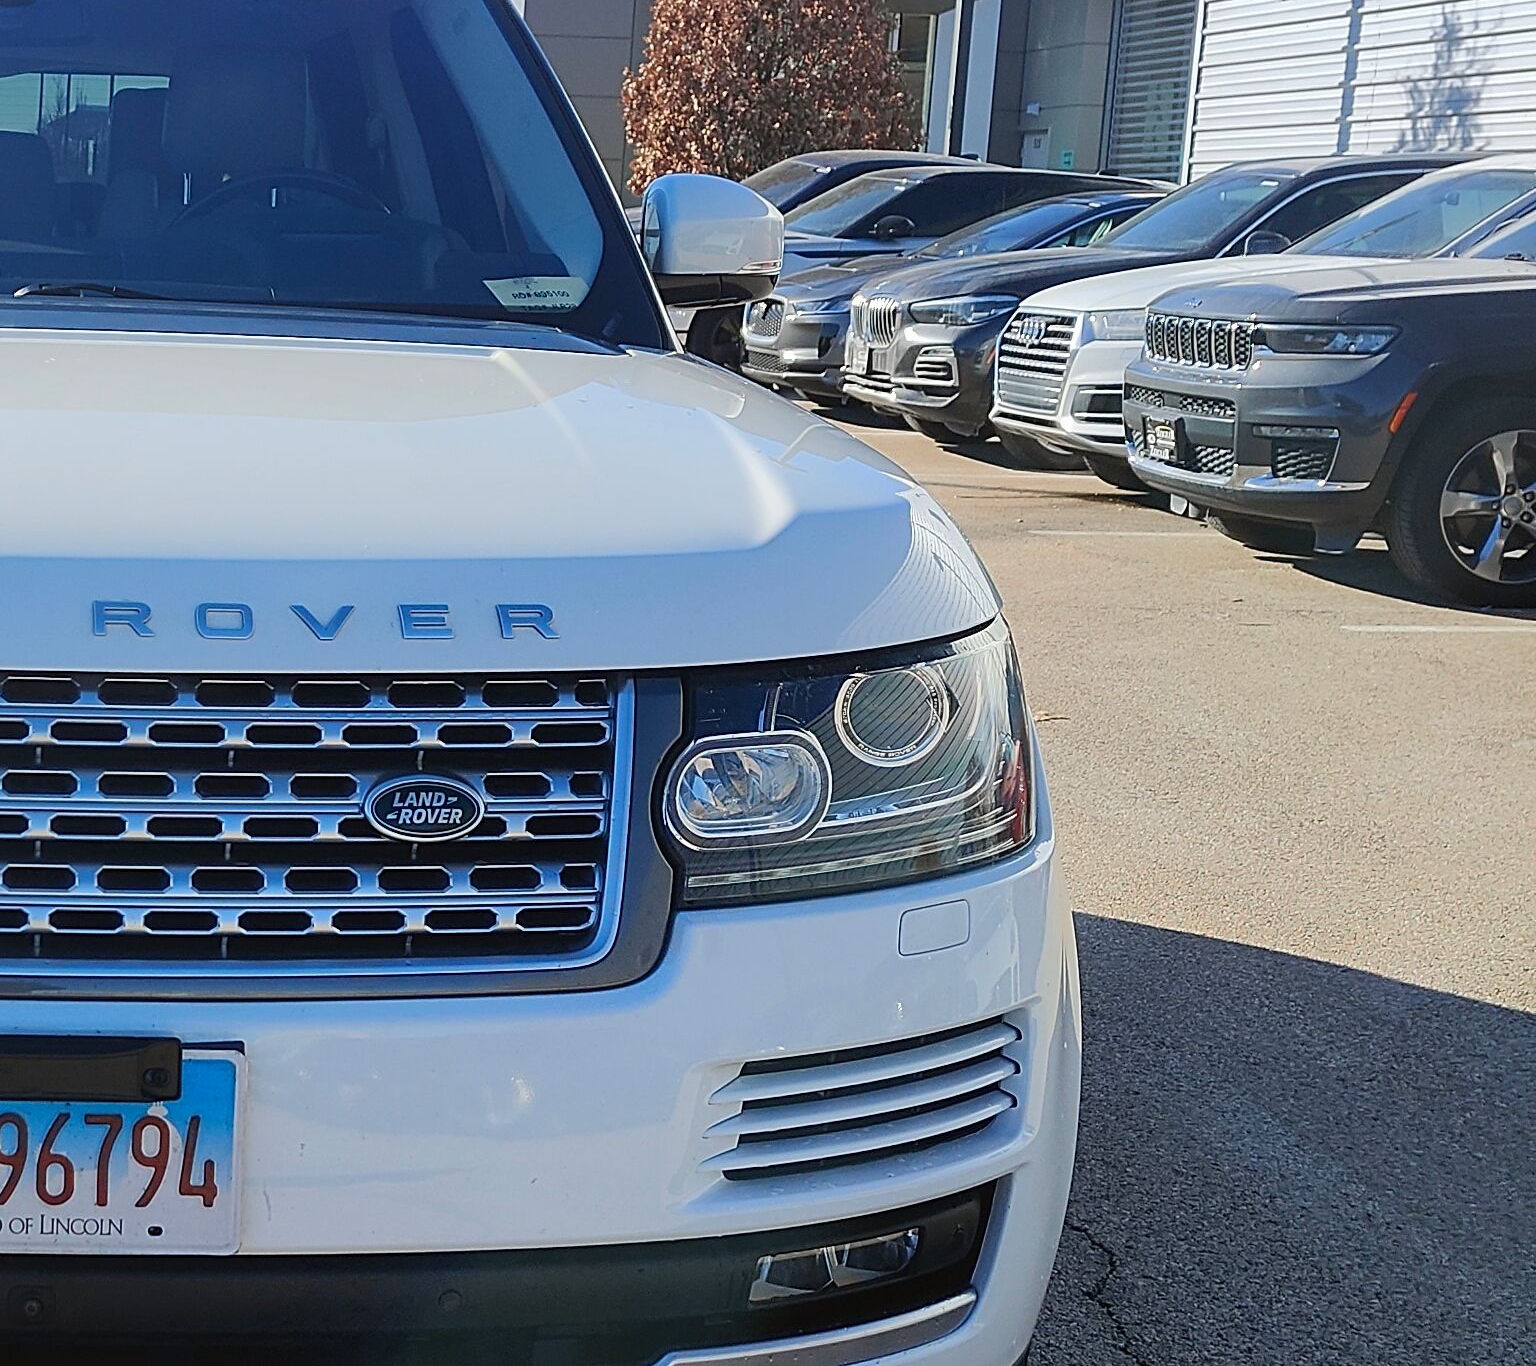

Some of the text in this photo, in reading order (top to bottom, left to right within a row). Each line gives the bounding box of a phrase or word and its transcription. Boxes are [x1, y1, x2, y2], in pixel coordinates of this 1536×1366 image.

[92, 599, 561, 641] ROVER
[392, 792, 446, 807] LAND
[398, 808, 463, 824] ROVER
